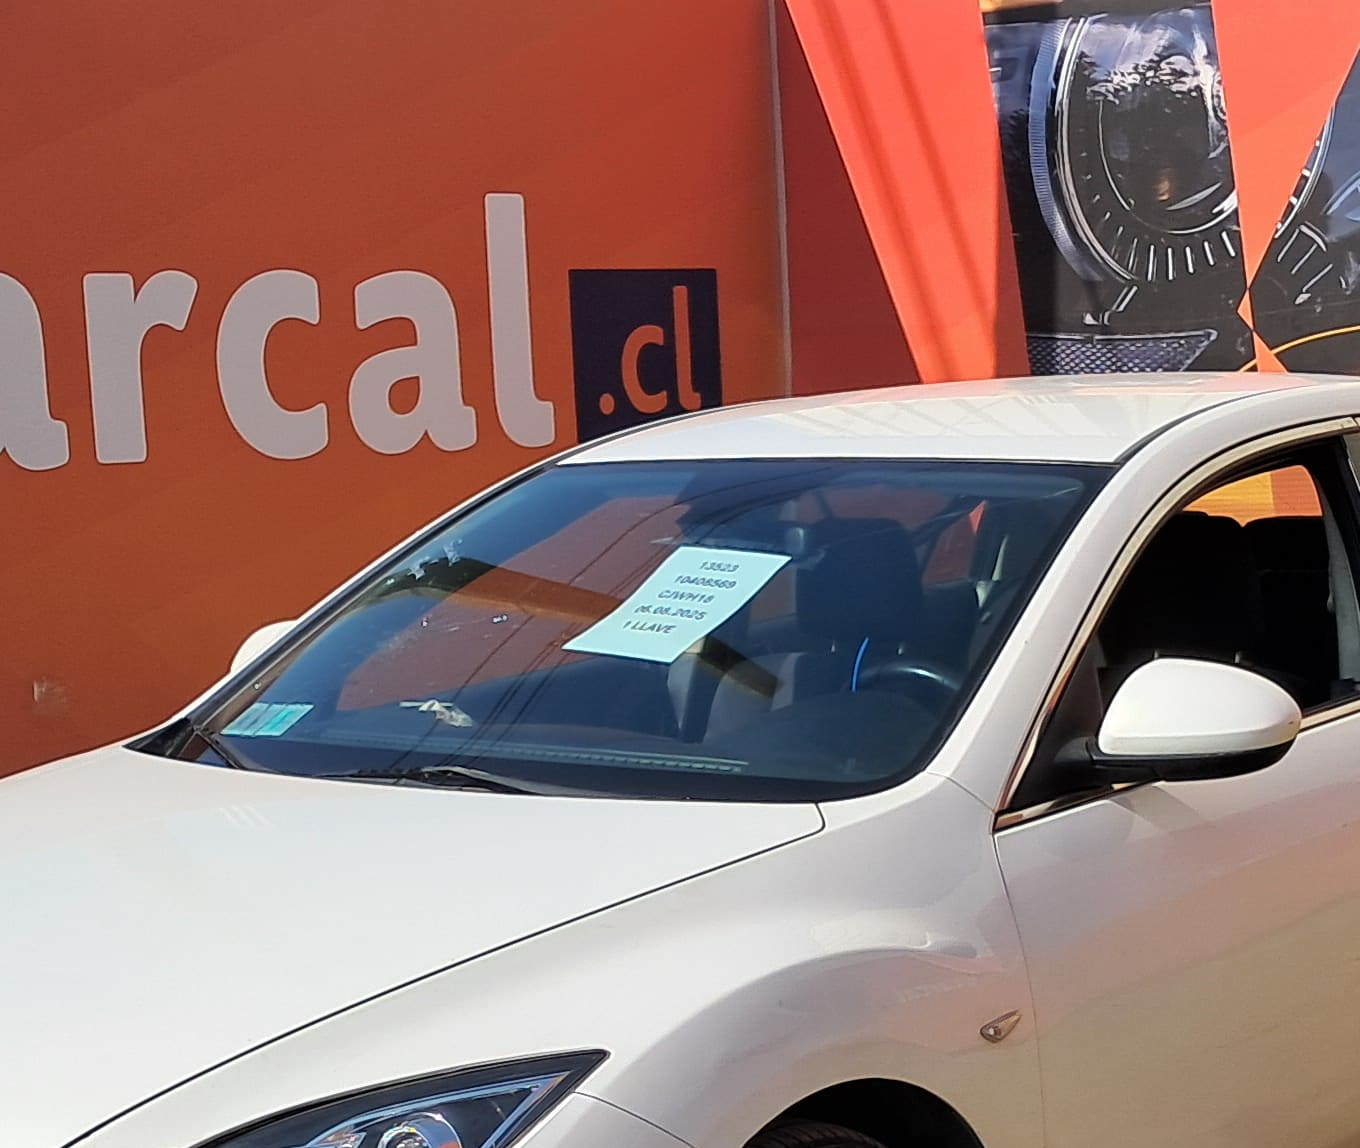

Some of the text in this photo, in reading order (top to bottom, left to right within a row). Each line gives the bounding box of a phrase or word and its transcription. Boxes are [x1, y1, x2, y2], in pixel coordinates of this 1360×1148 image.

[598, 285, 702, 416] .cl
[700, 561, 739, 572] 13523
[658, 590, 714, 603] CJWH18
[631, 621, 676, 633] LLAVE
